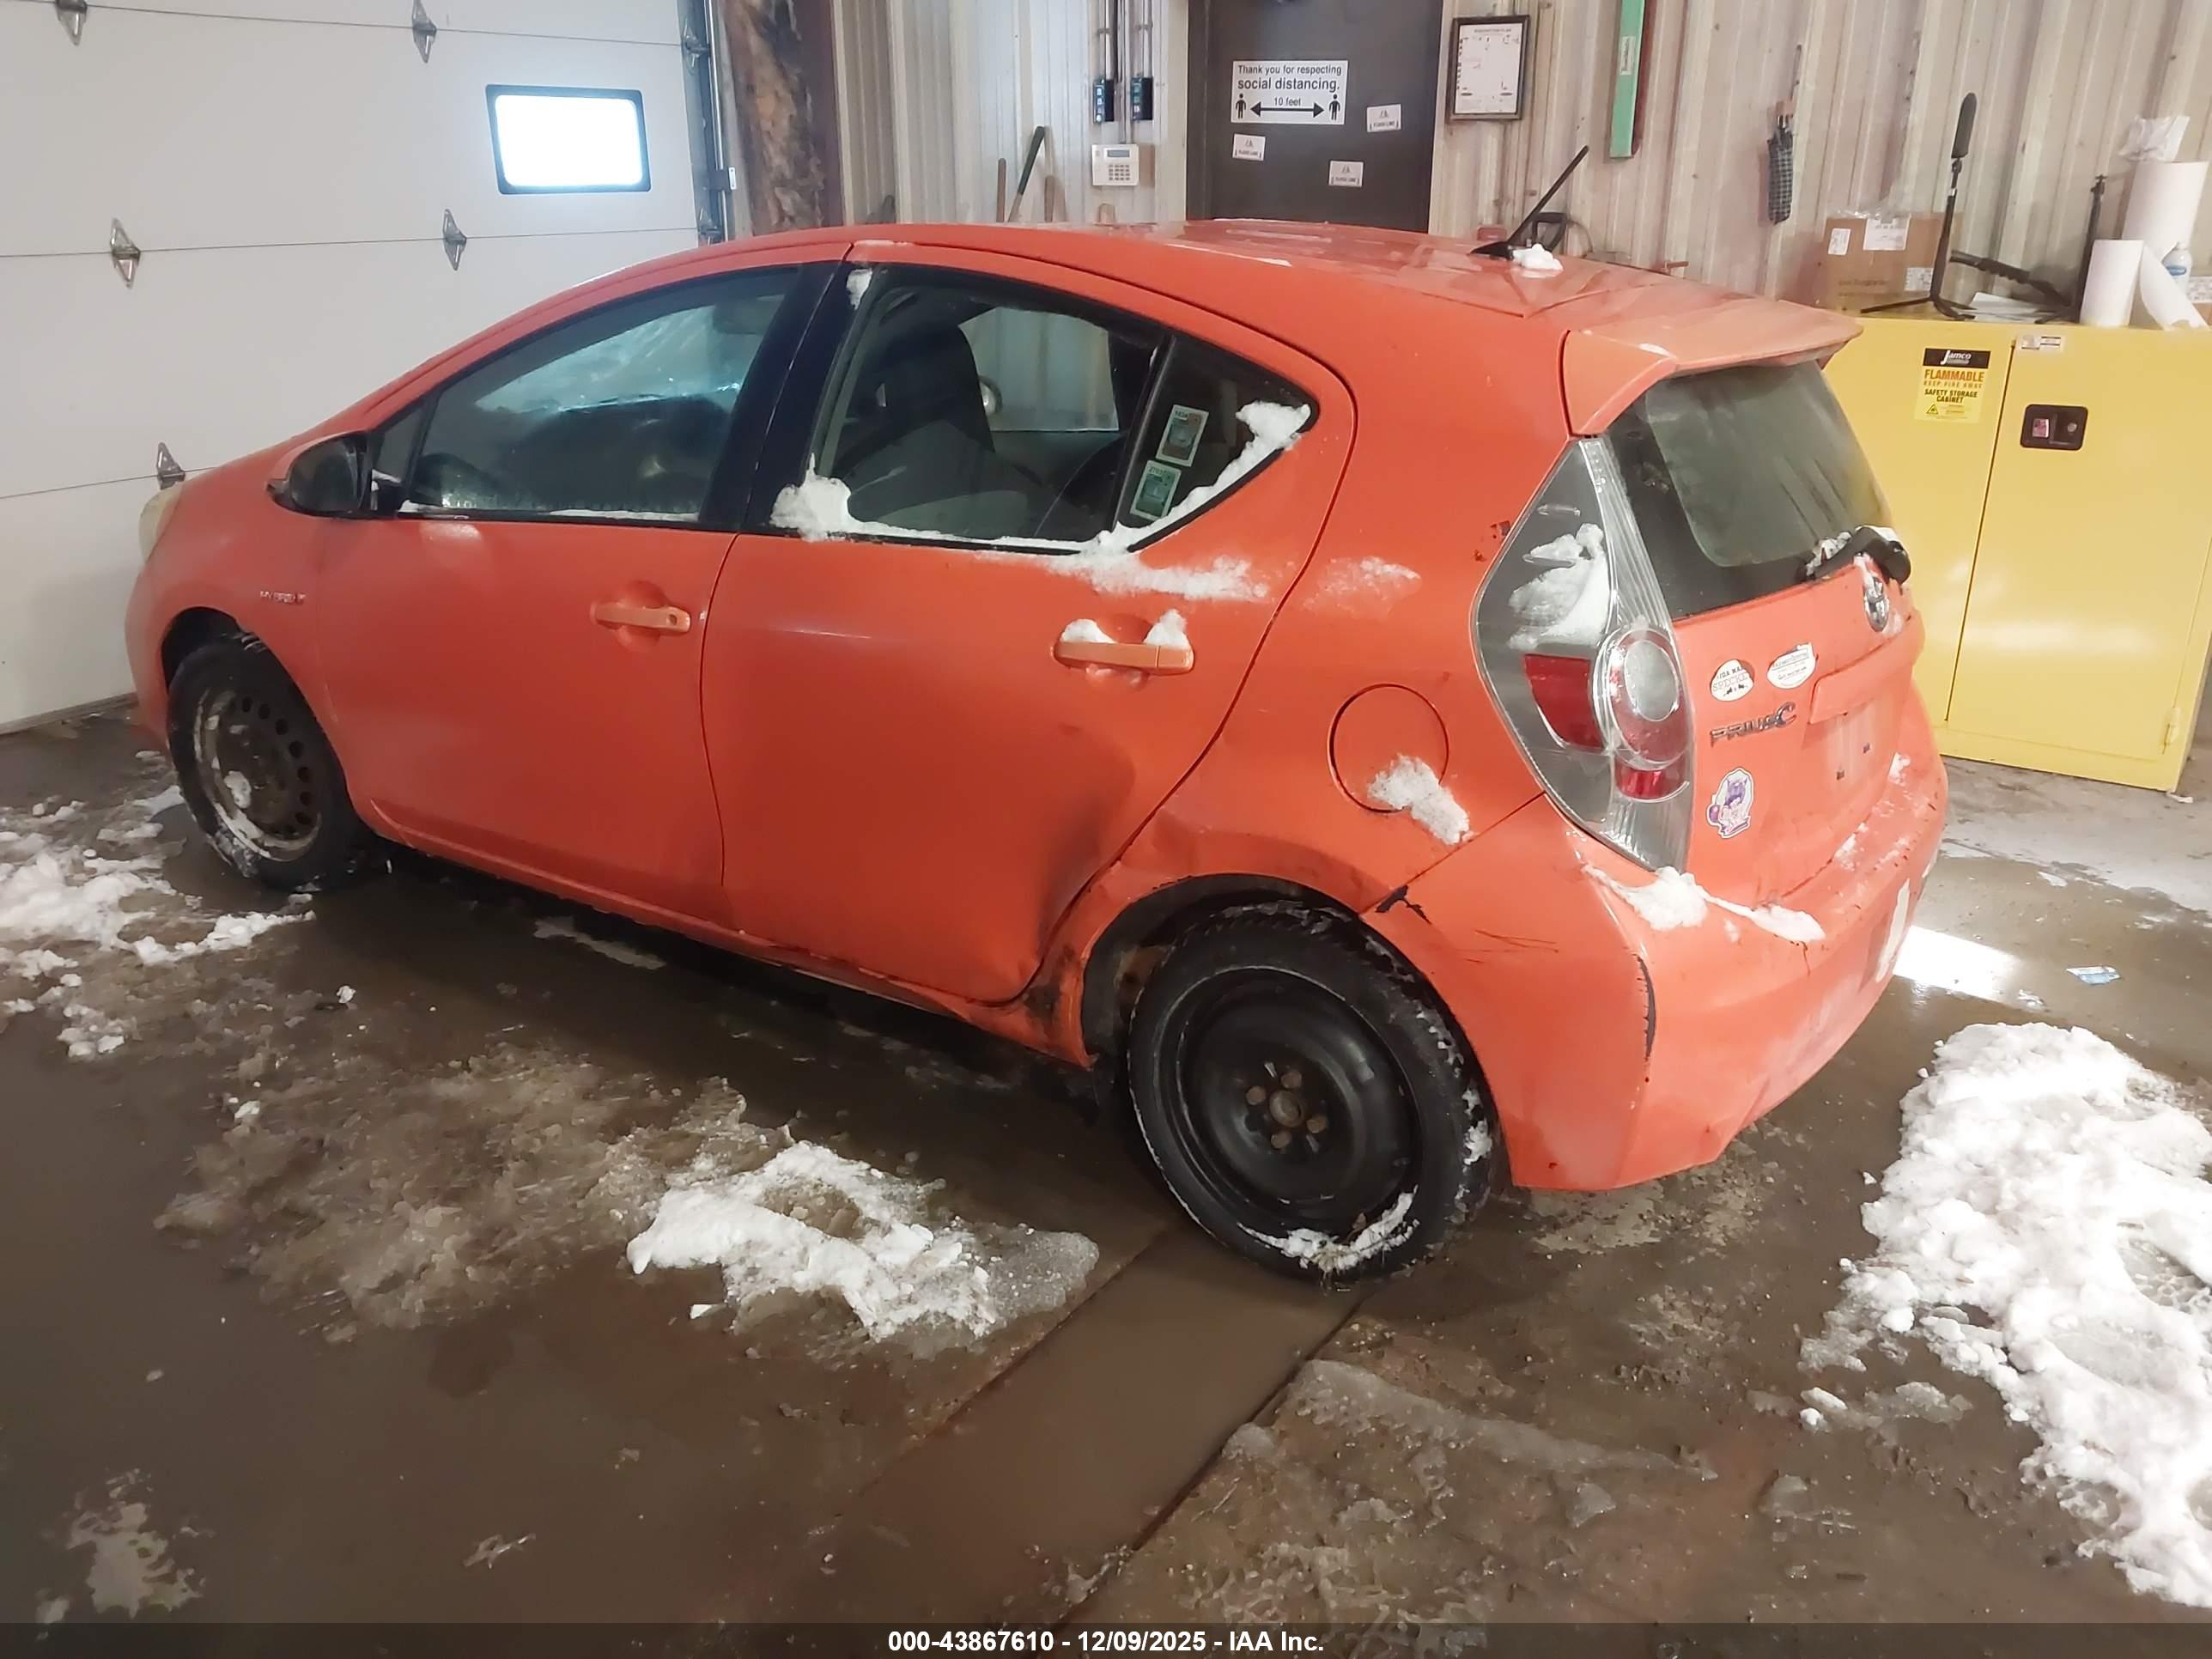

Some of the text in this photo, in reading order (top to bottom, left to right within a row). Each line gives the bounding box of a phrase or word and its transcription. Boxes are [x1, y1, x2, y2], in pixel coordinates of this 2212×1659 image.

[1238, 64, 1341, 76] Thank you for respecting
[1237, 77, 1340, 93] social distancing.
[1274, 97, 1301, 106] 10 feet
[1940, 349, 1972, 365] Jamco
[1924, 369, 1984, 382] FLAMMABLE
